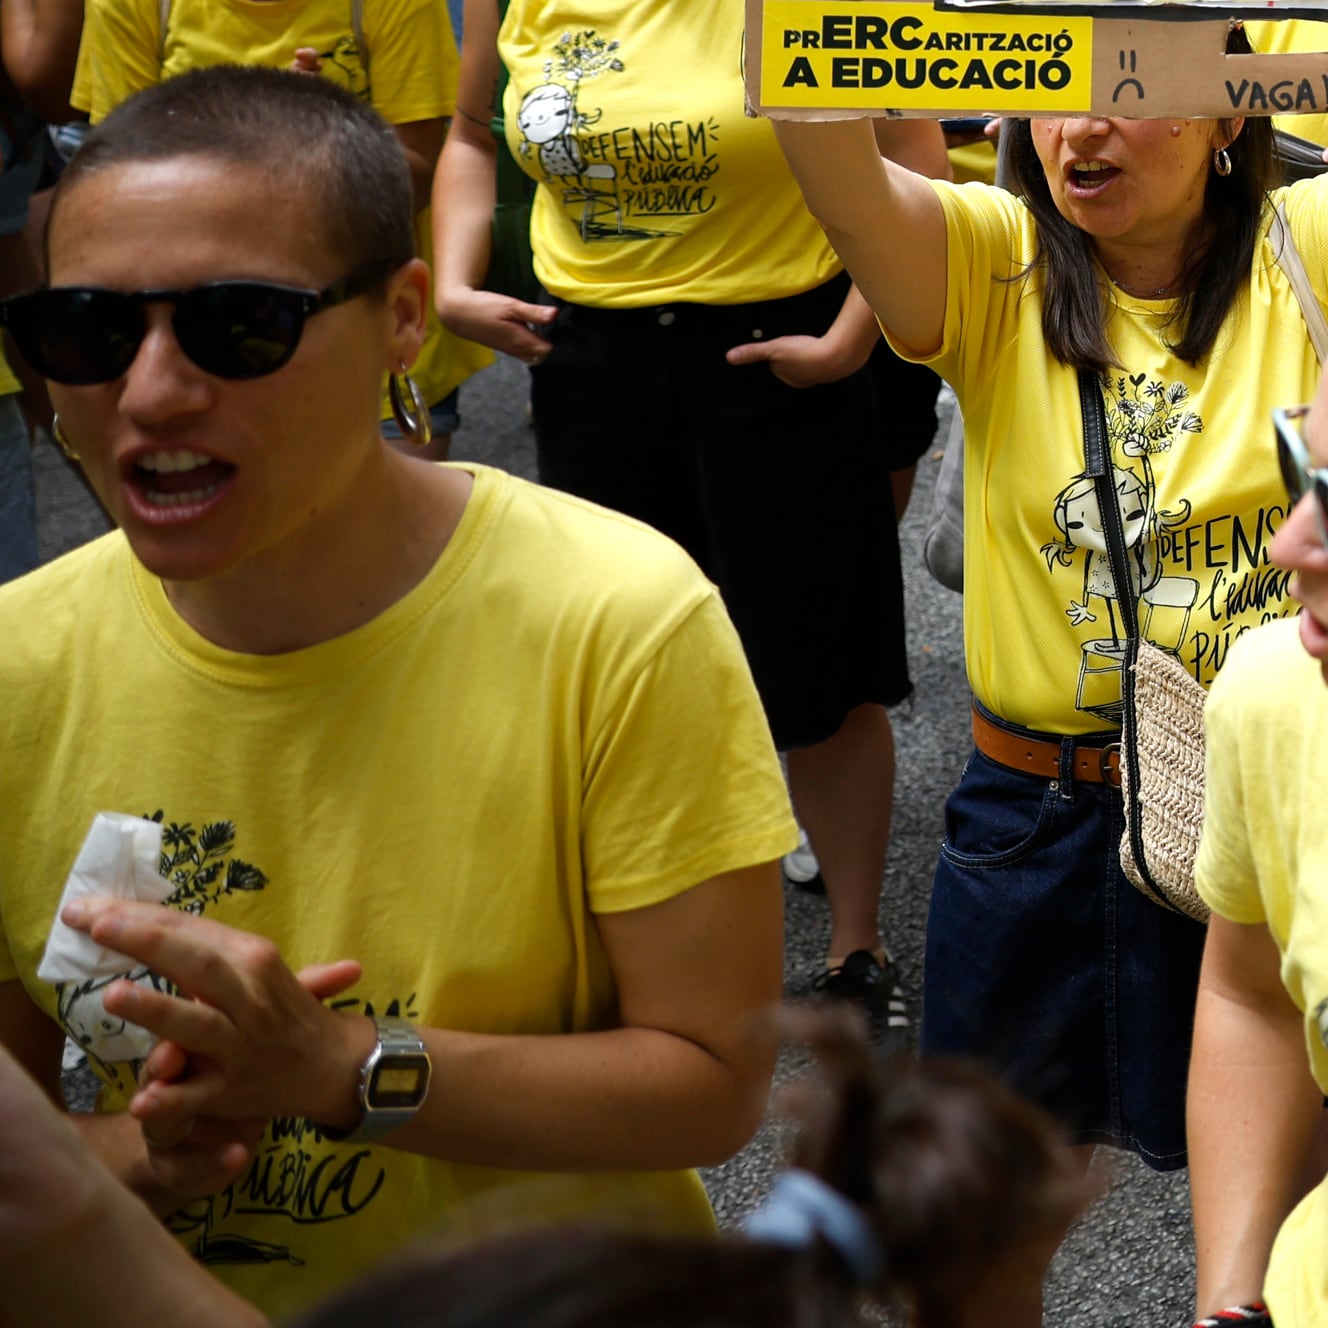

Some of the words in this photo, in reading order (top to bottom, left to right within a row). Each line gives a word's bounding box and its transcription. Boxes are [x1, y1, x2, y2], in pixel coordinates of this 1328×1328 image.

[782, 56, 819, 89] A
[831, 47, 1071, 90] EDUCACIÓ
[582, 120, 708, 162] DEFENSEM
